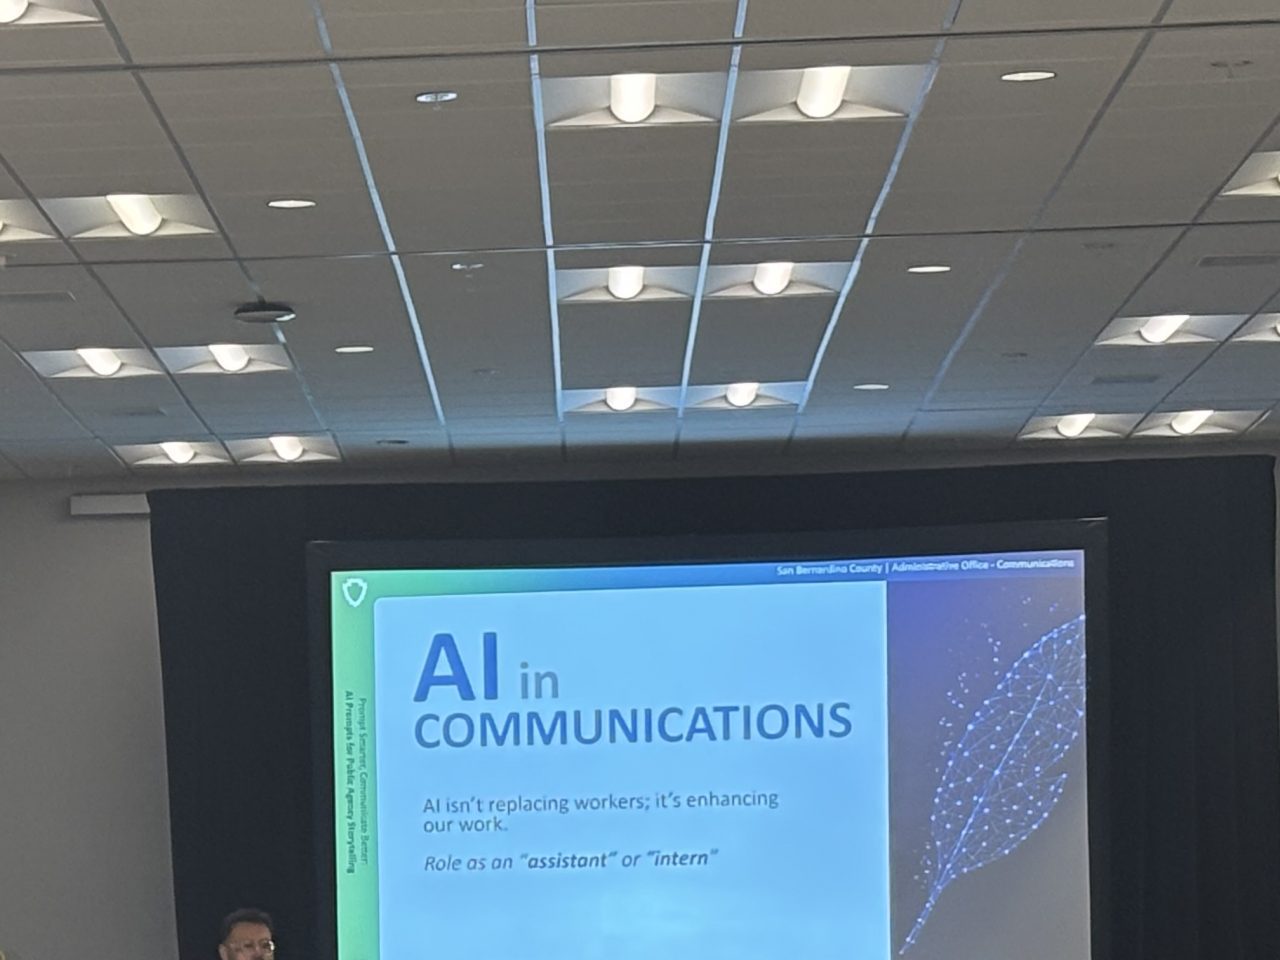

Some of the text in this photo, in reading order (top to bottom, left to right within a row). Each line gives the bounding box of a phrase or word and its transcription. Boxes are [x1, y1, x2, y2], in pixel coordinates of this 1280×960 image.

[777, 565, 794, 576] San
[796, 564, 847, 576] Bernardino
[849, 563, 882, 575] County
[891, 561, 959, 572] Administrative
[961, 559, 989, 570] Office
[996, 558, 1075, 570] Communications
[413, 632, 559, 702] AI in
[357, 698, 368, 731] Prompt
[414, 701, 852, 749] COMMUNICATIONS
[344, 691, 357, 874] AI Prompts for Public Agency Storytelling
[359, 772, 369, 833] Communicate
[423, 790, 779, 815] AI isn’t replacing workers; it’s enhancing
[423, 816, 508, 833] our work.
[424, 848, 719, 871] Role as an “assistant” or “intern”
